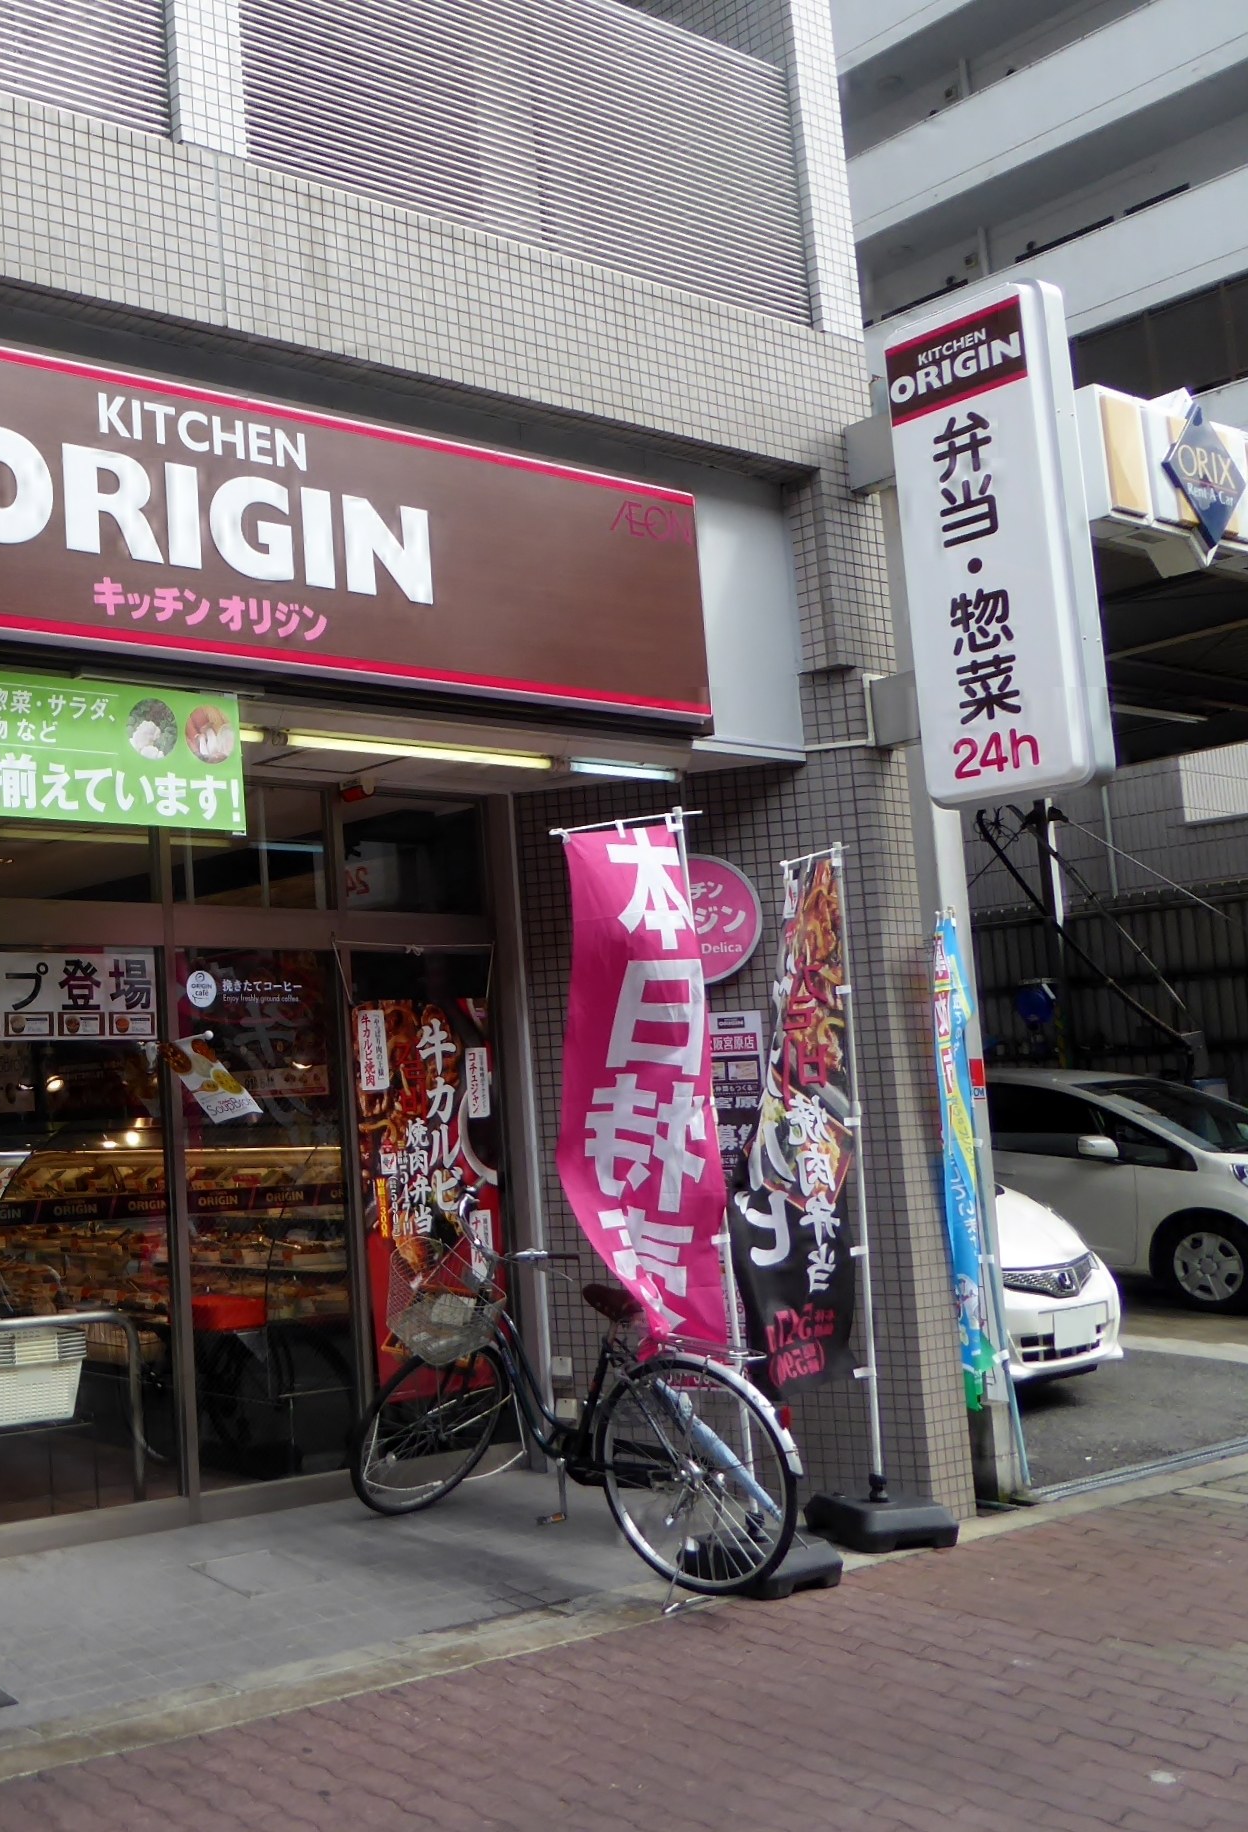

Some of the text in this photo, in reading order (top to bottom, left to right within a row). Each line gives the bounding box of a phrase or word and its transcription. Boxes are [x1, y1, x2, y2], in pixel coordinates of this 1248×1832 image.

[891, 331, 1021, 403] ORIGIN
[918, 328, 986, 366] KITCHEN
[97, 392, 307, 471] KITCHEN
[1178, 444, 1236, 490] ORIX
[932, 411, 1023, 726] 弁当・惣菜
[93, 576, 328, 642] キッチン オリジン
[17, 718, 57, 743] など
[953, 728, 1040, 779] 24h
[701, 941, 743, 954] Delica
[222, 978, 303, 992] 挽きたてコーヒー
[222, 994, 239, 1003] Enjoy
[240, 993, 260, 1003] freshly
[260, 994, 280, 1003] ground
[361, 1014, 377, 1087] 牛カルビ焼肉
[710, 1035, 755, 1051] 阪宮原店
[468, 1052, 479, 1114] コチュジャン
[416, 1018, 464, 1211] 牛カルビ
[197, 1194, 238, 1207] ORIGIN
[265, 1190, 304, 1203] ORIGIN
[405, 1118, 433, 1235] 焼肉弁当
[53, 1203, 98, 1217] ORIGIN
[471, 1216, 484, 1266] ナル
